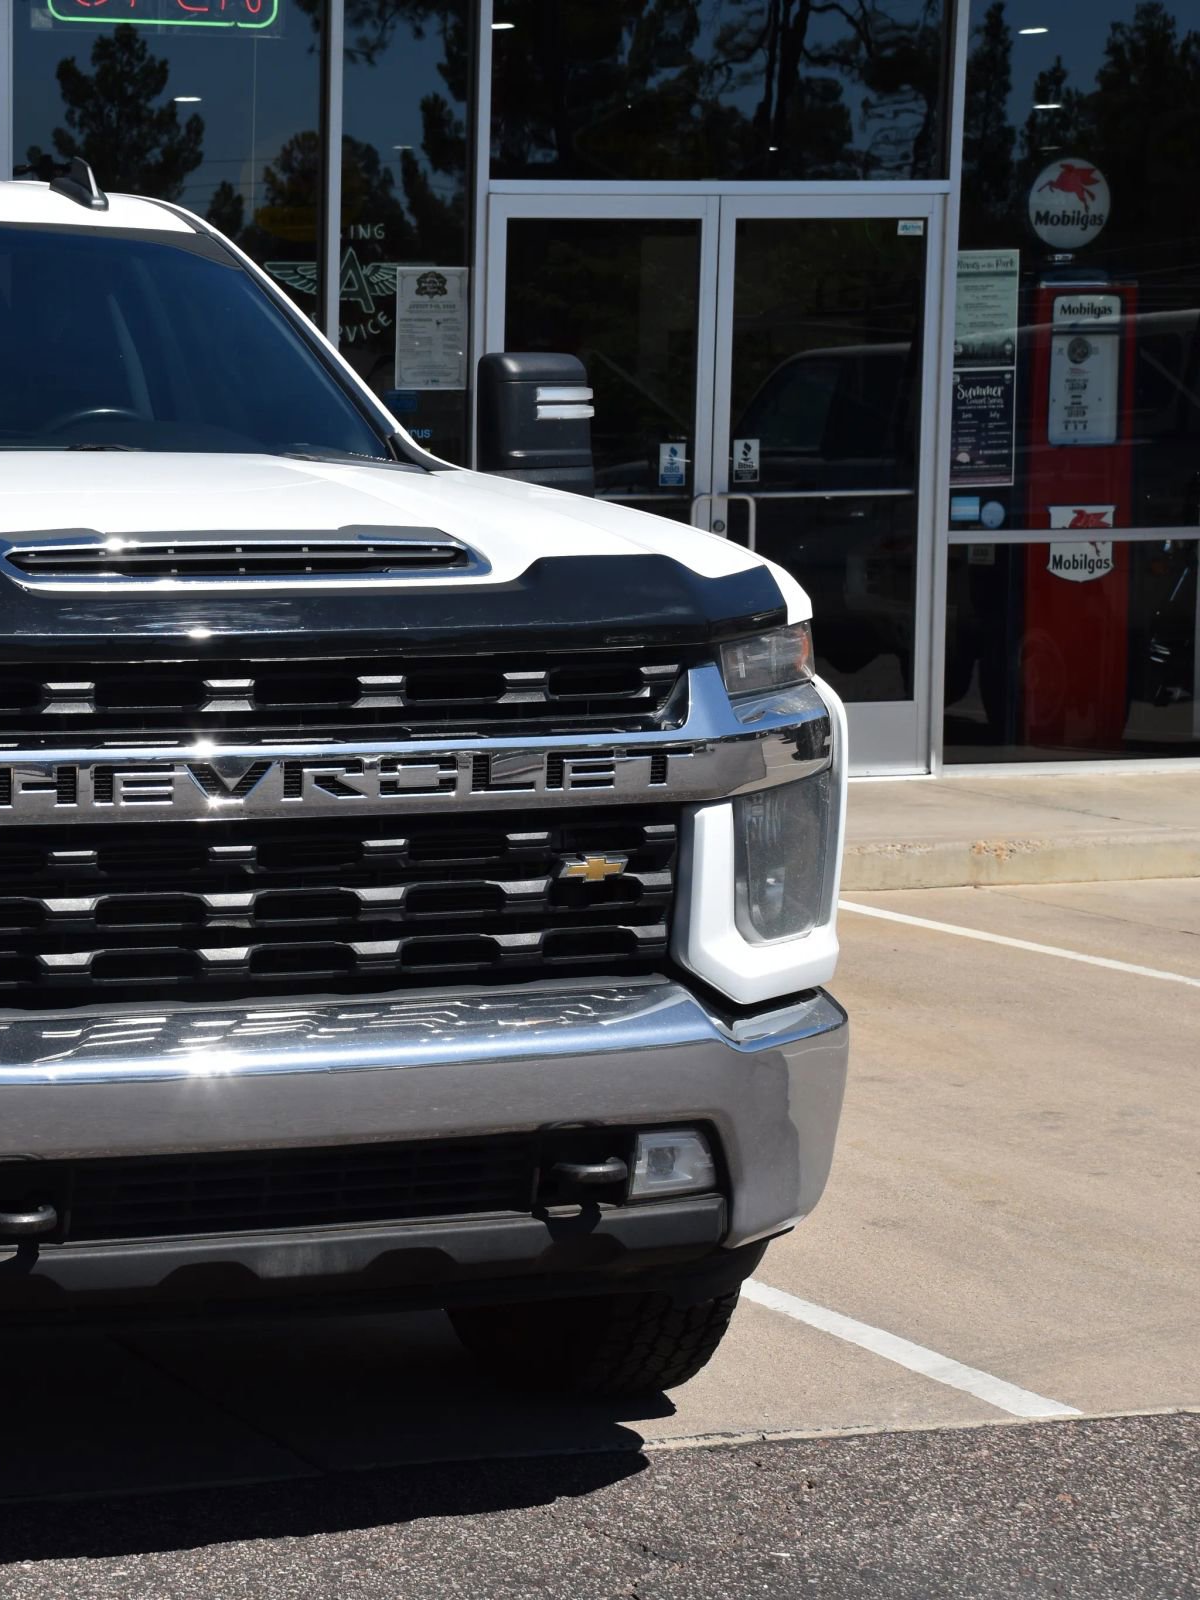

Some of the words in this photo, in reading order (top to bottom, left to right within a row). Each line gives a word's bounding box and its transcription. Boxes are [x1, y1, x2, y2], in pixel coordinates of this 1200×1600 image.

[1035, 210, 1104, 231] Mobilgas
[1059, 302, 1113, 318] Mobilgas
[957, 384, 1004, 400] Summer
[1052, 553, 1110, 574] Mobilgas
